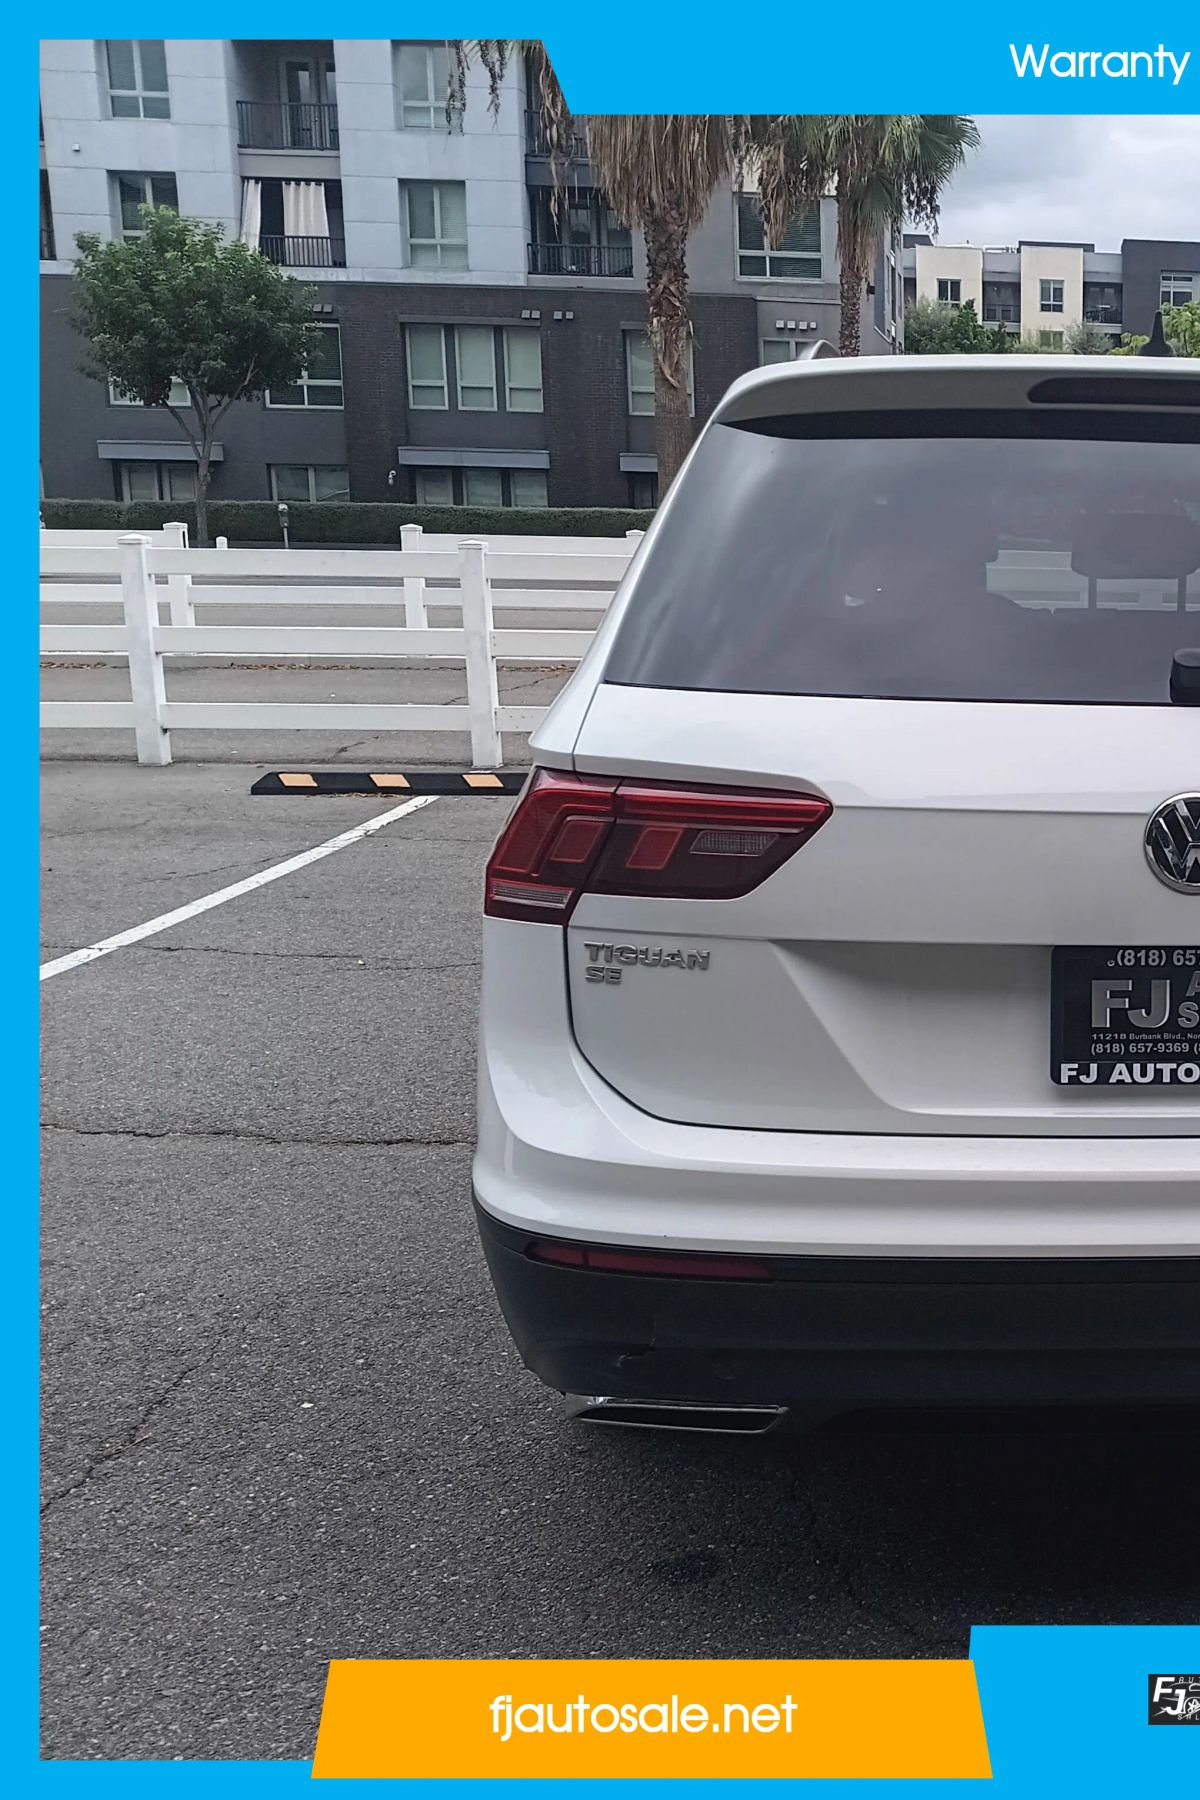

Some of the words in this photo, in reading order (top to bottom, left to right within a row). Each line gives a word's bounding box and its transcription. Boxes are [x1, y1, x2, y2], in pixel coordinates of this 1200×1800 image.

[583, 941, 711, 971] TIGUAN
[1116, 949, 1167, 967] (818)
[584, 965, 623, 985] SE
[1091, 979, 1170, 1029] FJ
[1091, 1043, 1125, 1056] (818)
[1129, 1042, 1190, 1053] 657-9369
[1060, 1063, 1098, 1083] FJ
[1109, 1062, 1200, 1083] AUTO
